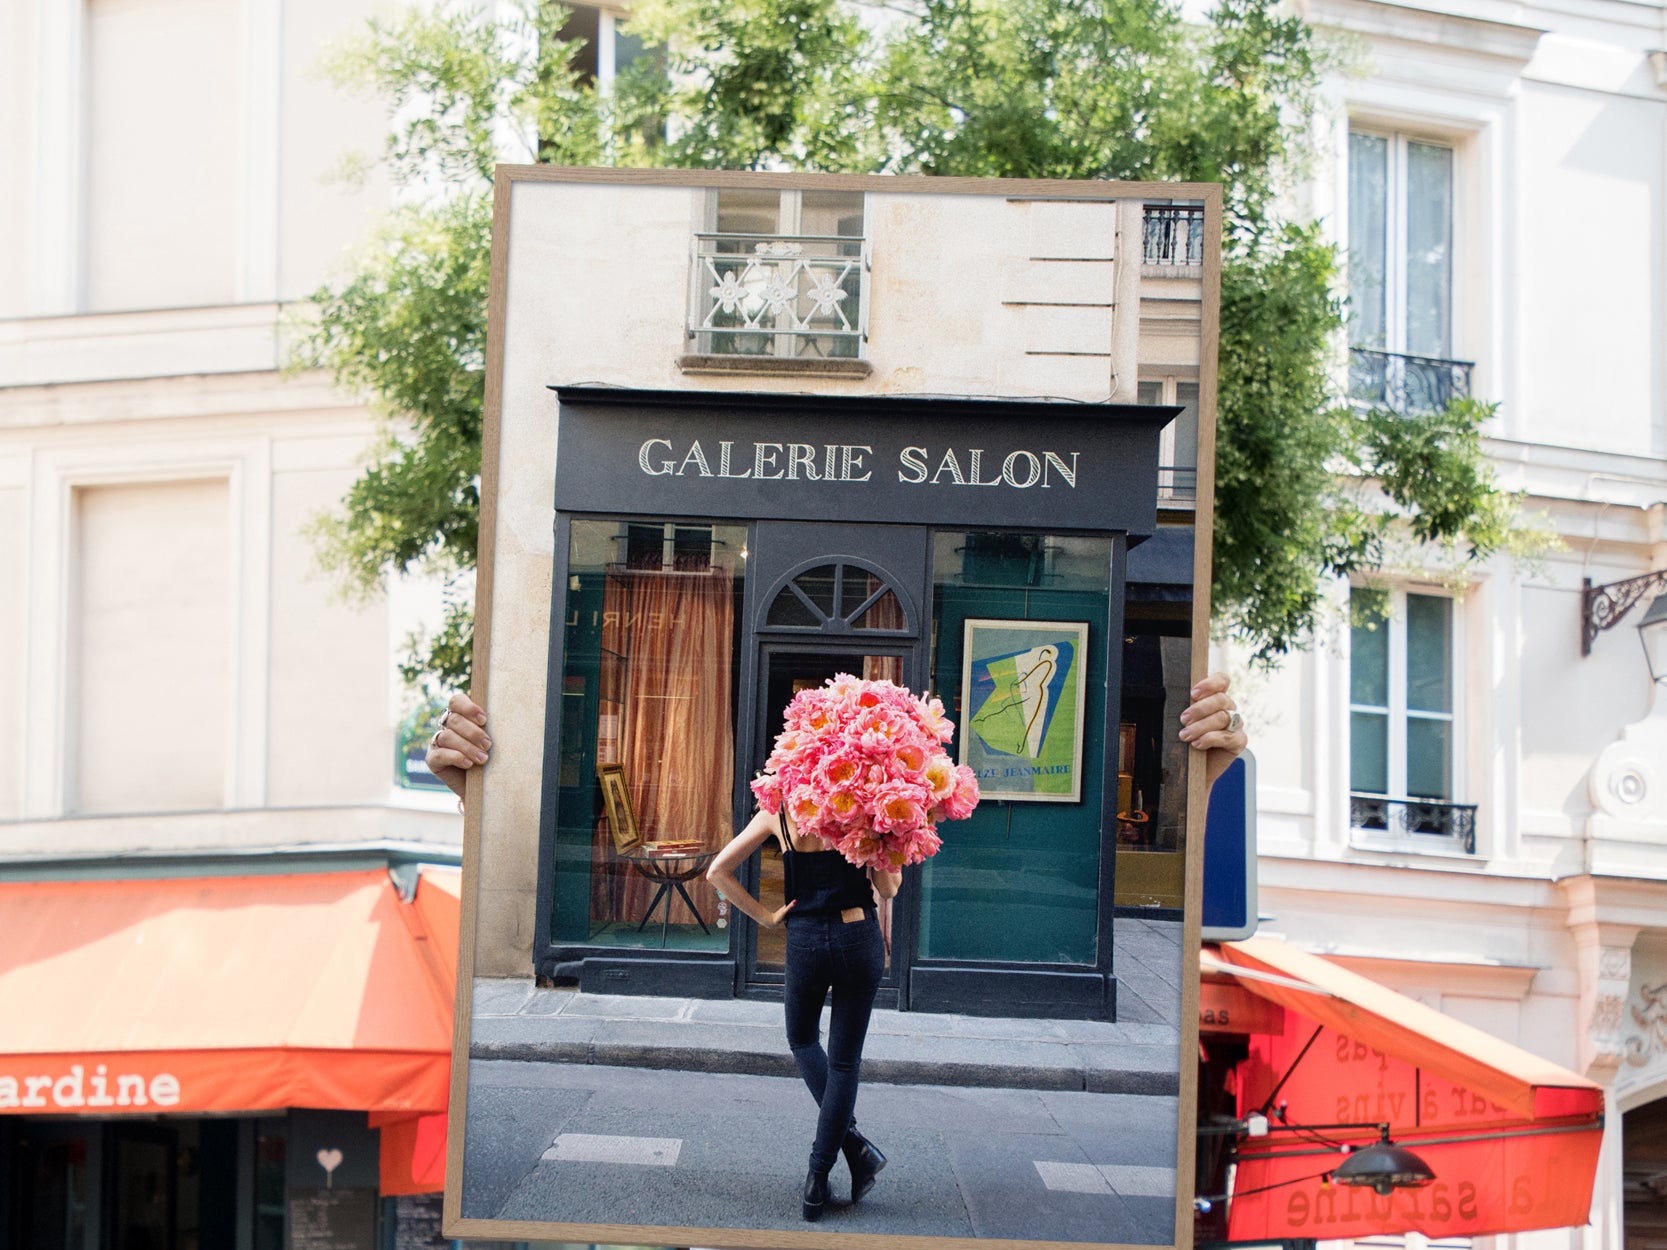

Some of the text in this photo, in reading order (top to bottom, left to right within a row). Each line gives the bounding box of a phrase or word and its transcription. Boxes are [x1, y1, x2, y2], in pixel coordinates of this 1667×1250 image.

[638, 438, 1080, 489] GALERIE SALON
[1004, 765, 1070, 778] JEANMAIRE
[1199, 1009, 1229, 1026] as
[0, 1064, 181, 1108] ardine
